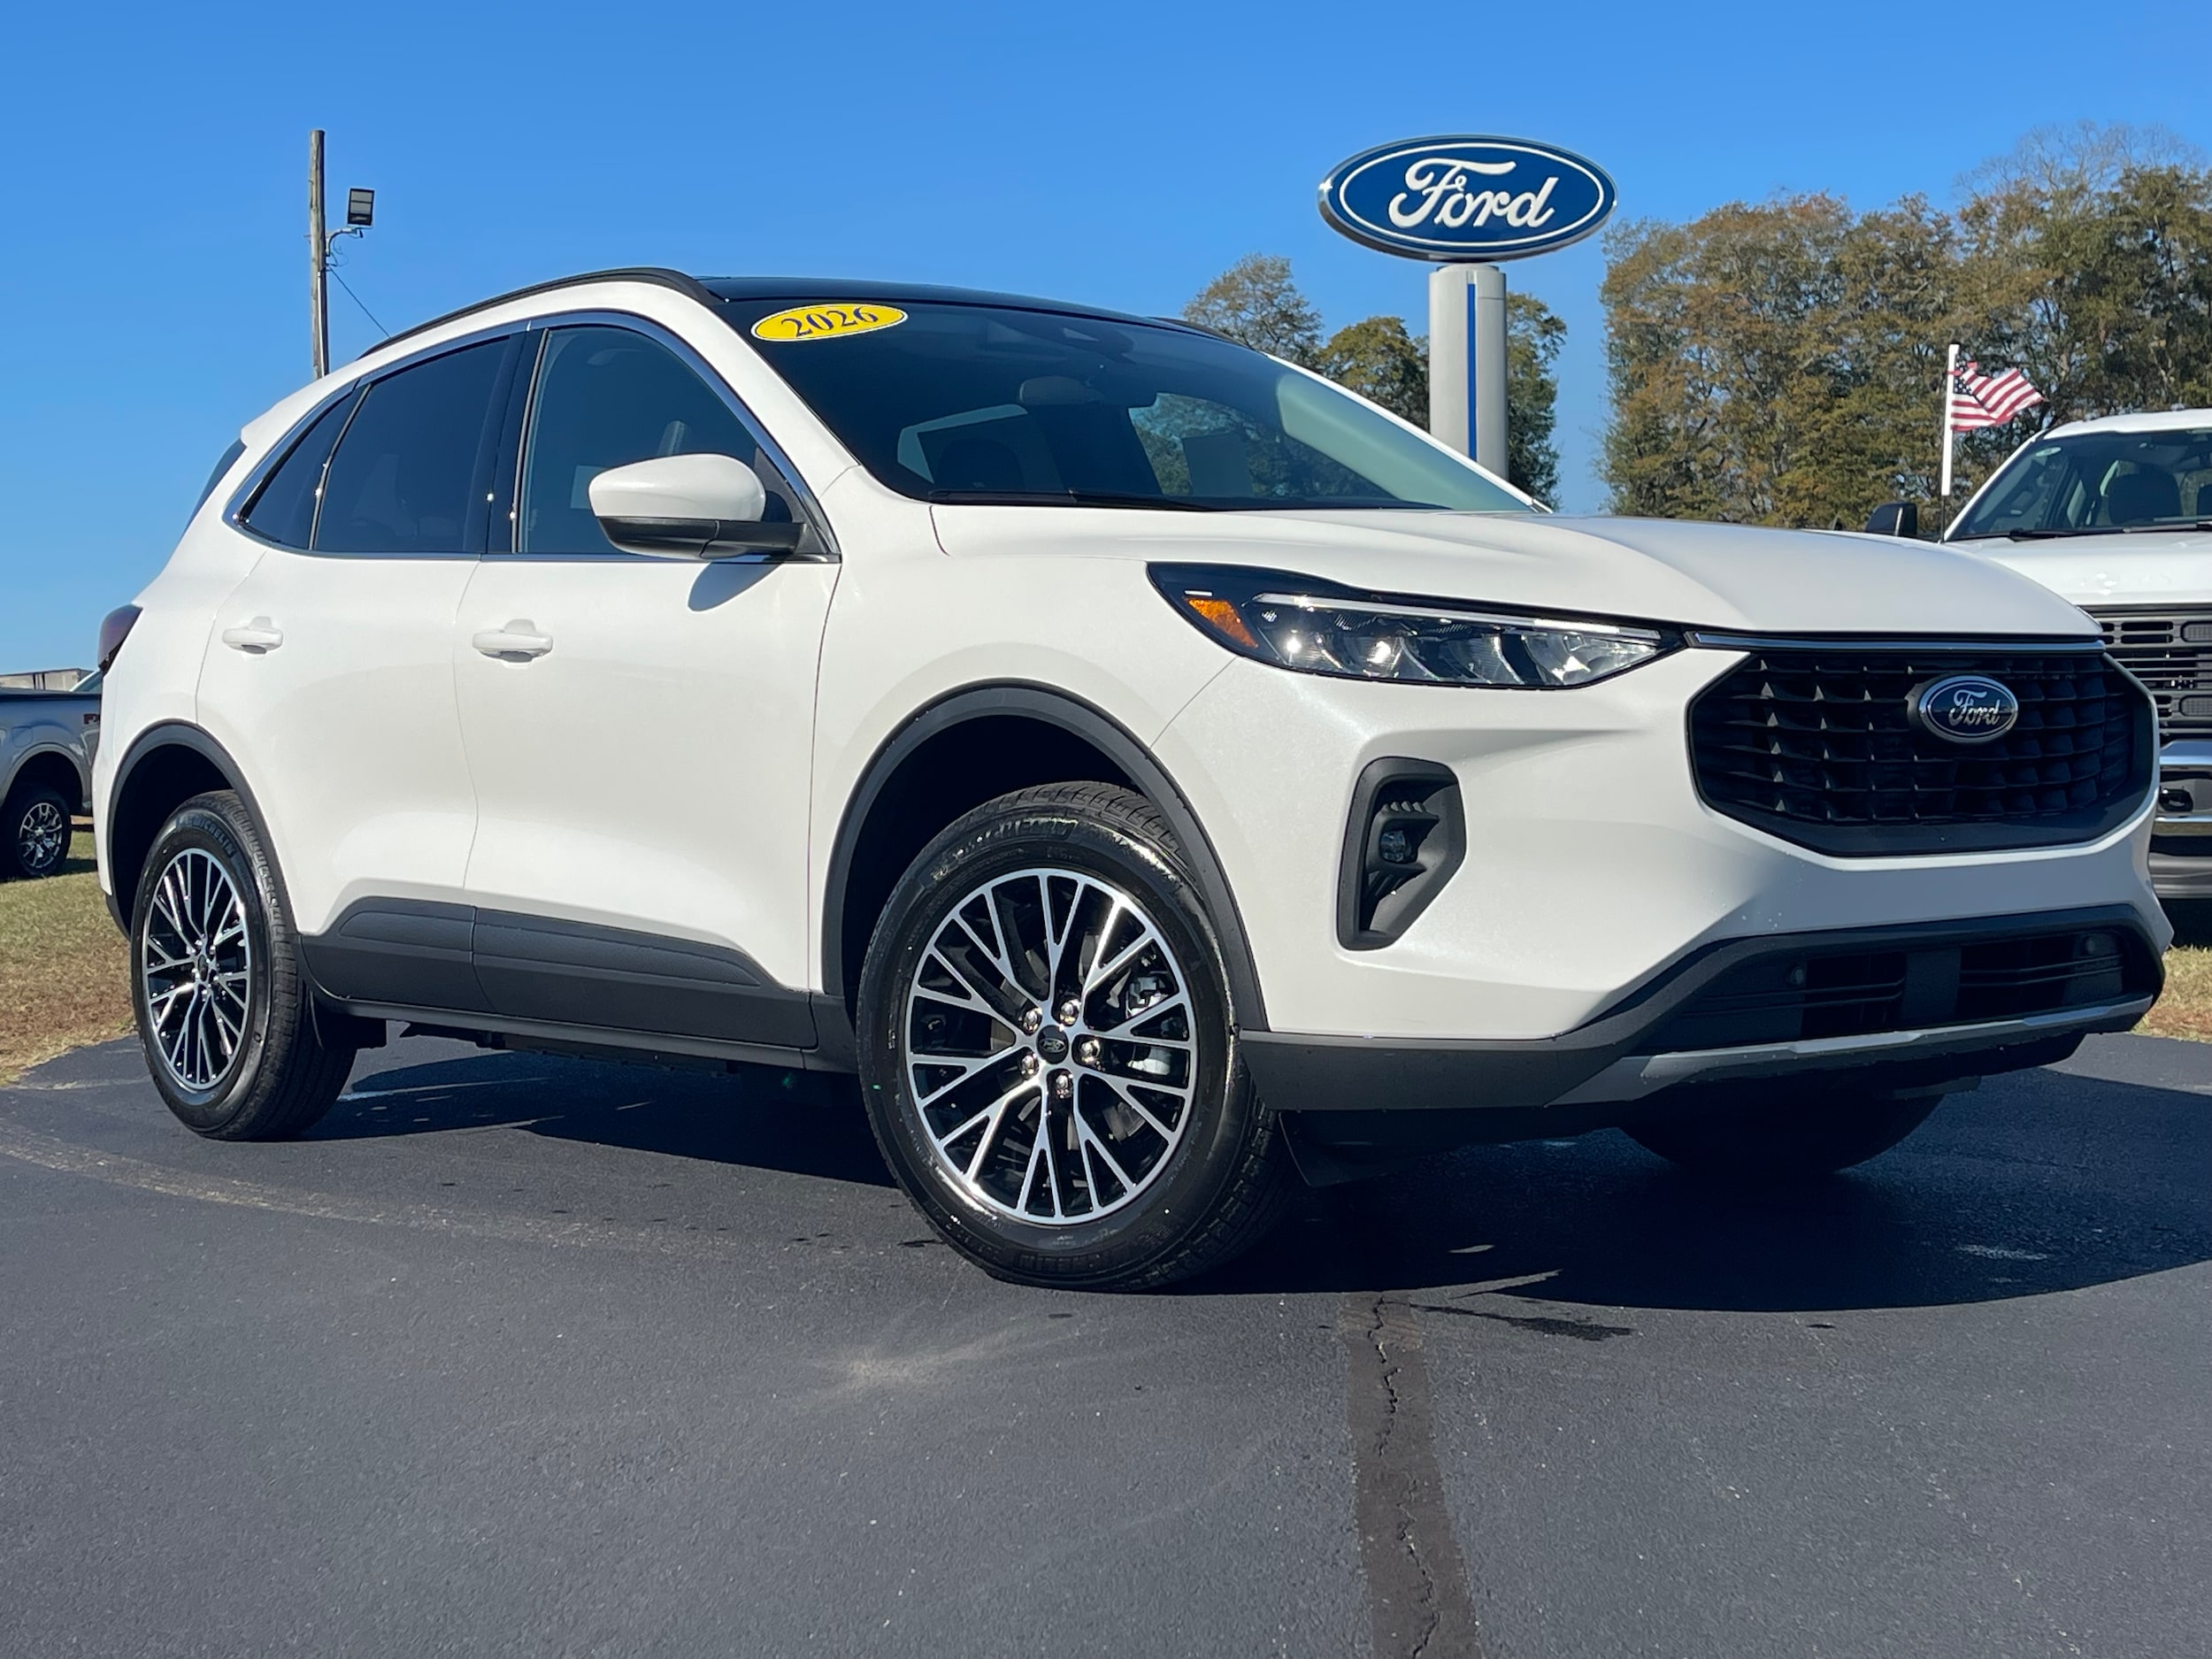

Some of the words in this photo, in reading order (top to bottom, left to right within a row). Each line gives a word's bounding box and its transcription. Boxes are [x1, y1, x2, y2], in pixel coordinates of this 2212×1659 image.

[1388, 157, 1559, 228] Ford
[780, 306, 879, 338] 2026
[1948, 689, 2001, 726] Ford
[192, 816, 237, 858] MICHELIN
